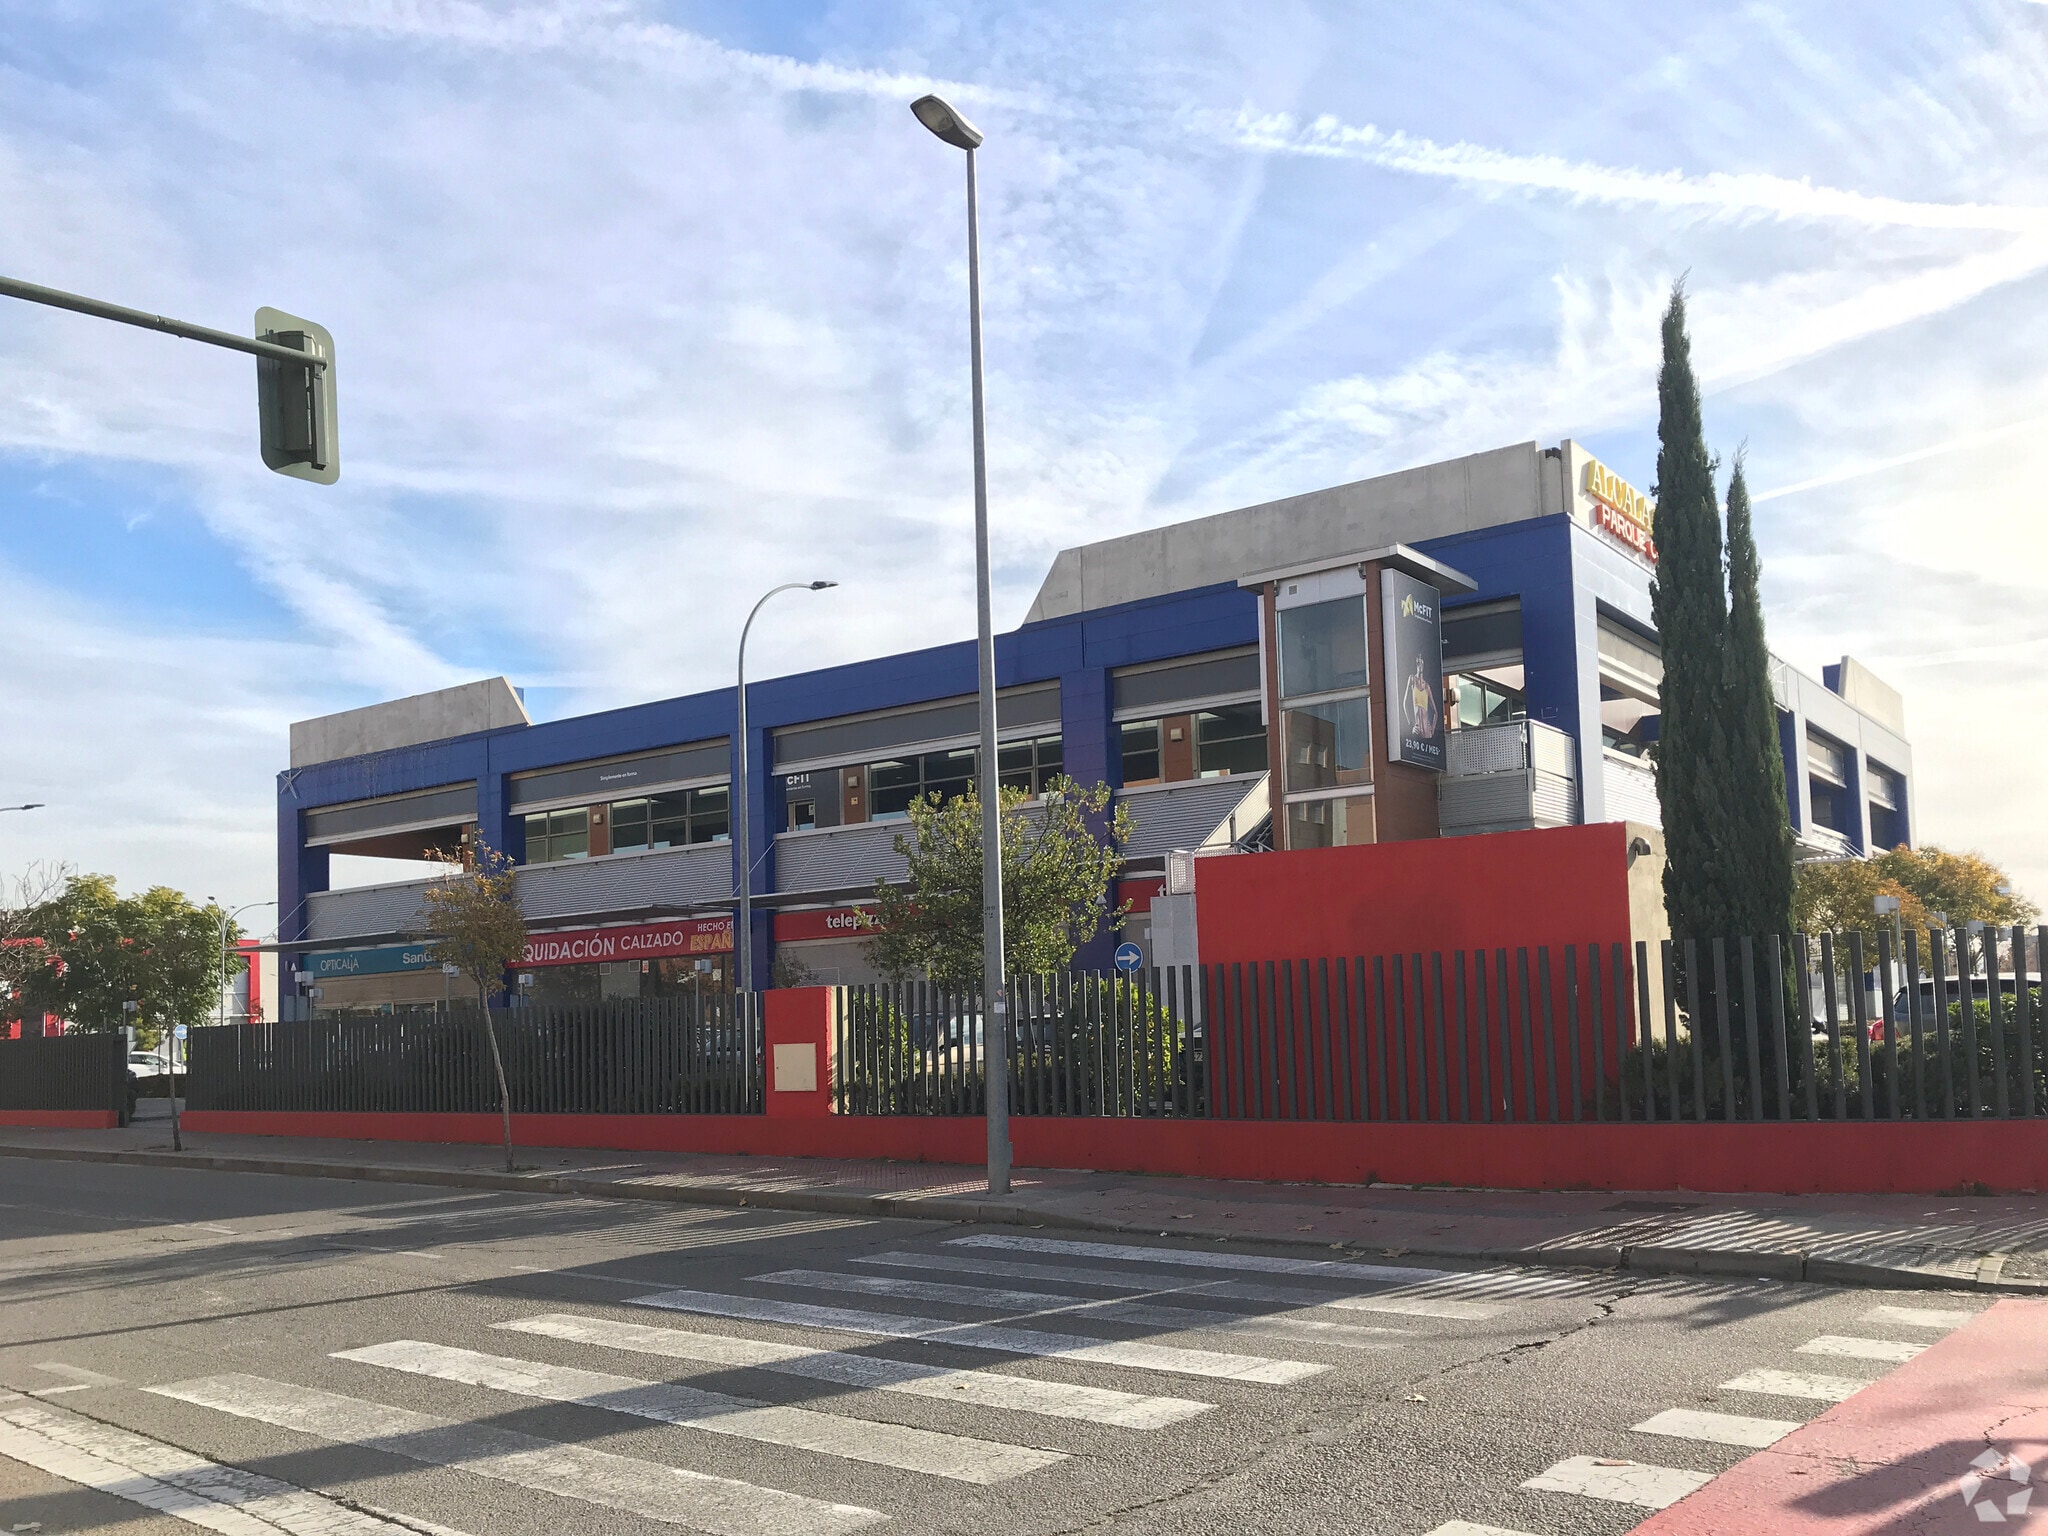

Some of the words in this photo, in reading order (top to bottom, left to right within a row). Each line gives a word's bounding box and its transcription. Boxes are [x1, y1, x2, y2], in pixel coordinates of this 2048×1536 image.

[1586, 459, 1654, 536] ALCALA
[1597, 503, 1647, 553] PARQUE
[690, 930, 734, 951] ESPAÑ
[697, 921, 725, 932] HECHO
[511, 933, 615, 963] QUIDACIÓN
[620, 931, 683, 950] CALZADO
